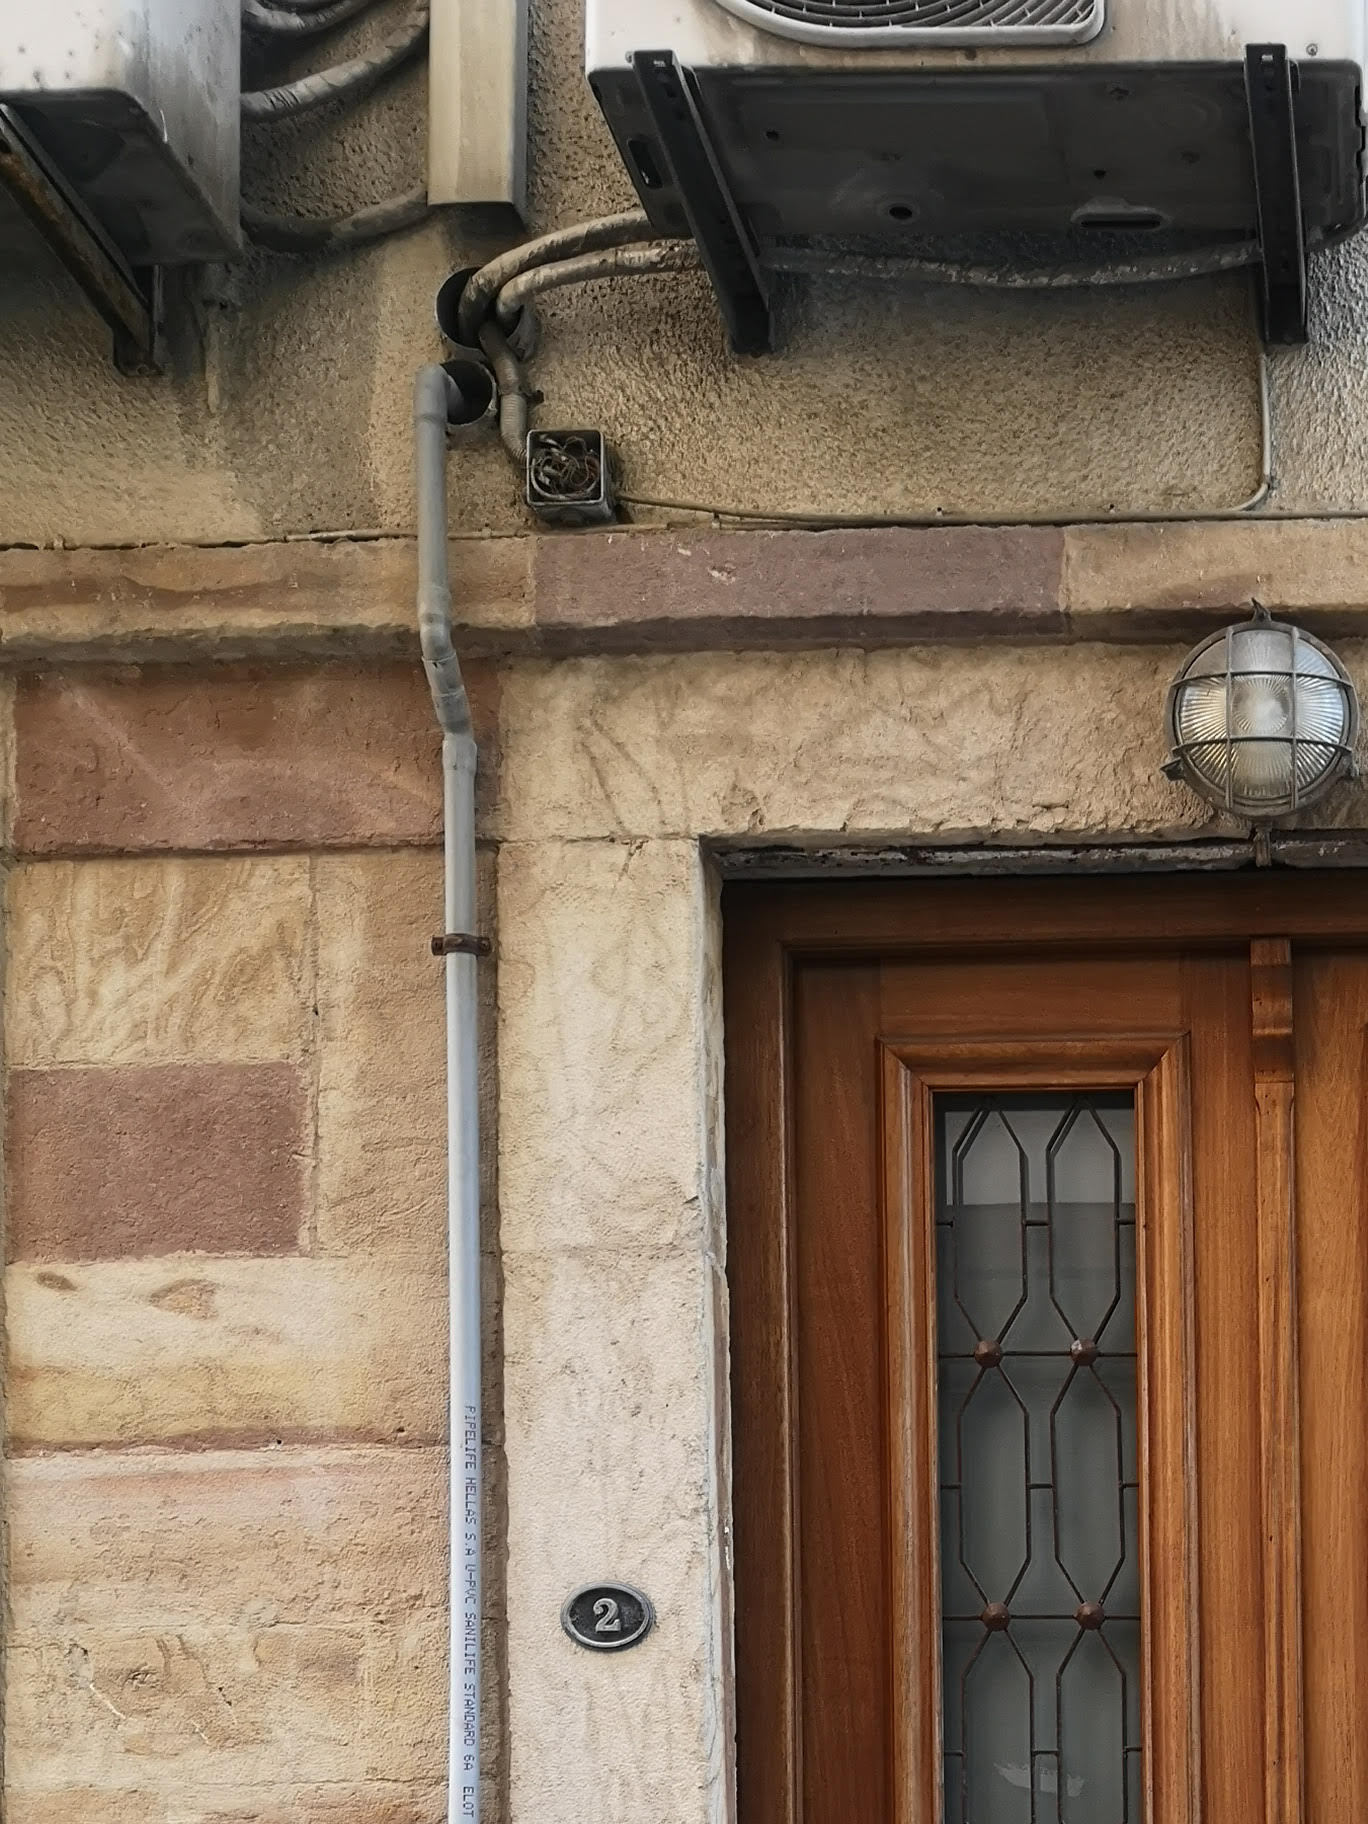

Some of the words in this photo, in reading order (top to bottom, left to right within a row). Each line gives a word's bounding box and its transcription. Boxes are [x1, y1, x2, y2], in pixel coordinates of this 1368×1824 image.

[464, 1405, 477, 1470] PIPELIFE
[464, 1476, 477, 1525] HELLAS
[464, 1532, 477, 1556] S.A
[464, 1563, 477, 1604] U-PVC
[593, 1598, 621, 1632] 2
[464, 1612, 477, 1675] SANILIFE
[463, 1682, 476, 1746] STANDARD
[463, 1754, 475, 1771] 6A
[462, 1786, 475, 1818] ELOT
